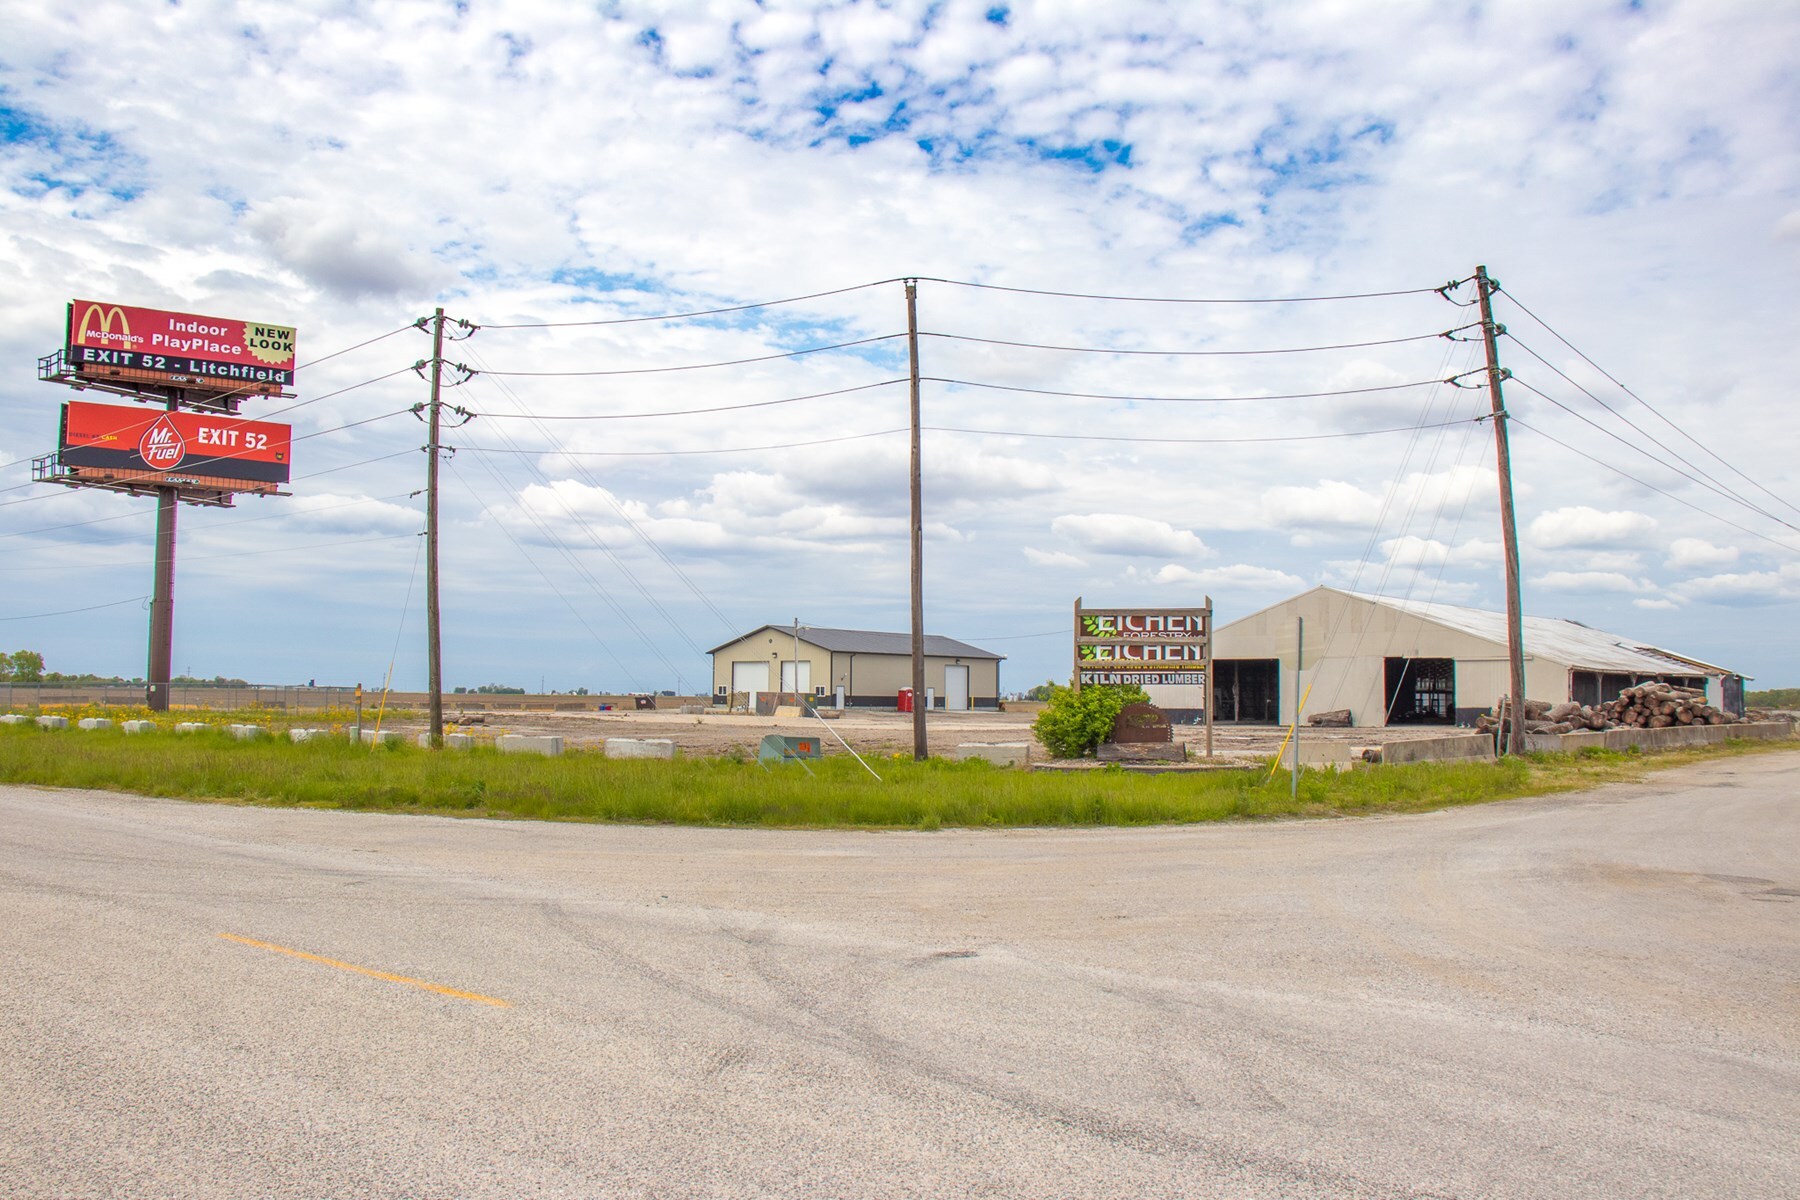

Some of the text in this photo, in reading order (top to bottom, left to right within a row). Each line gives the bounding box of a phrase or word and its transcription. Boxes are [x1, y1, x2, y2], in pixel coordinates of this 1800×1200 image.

[169, 318, 228, 336] Indoor
[254, 326, 290, 340] NEW
[86, 330, 144, 343] McDonald's
[152, 333, 242, 355] PlayPlace
[249, 338, 293, 352] LOOK
[83, 348, 133, 365] EXIT
[142, 355, 166, 369] 52
[189, 360, 285, 383] Litchfield
[148, 427, 173, 445] Mr.
[198, 427, 268, 450] EXIT 52
[147, 442, 180, 461] Fuel
[1080, 673, 1205, 685] KILN DRIED LUMBER
